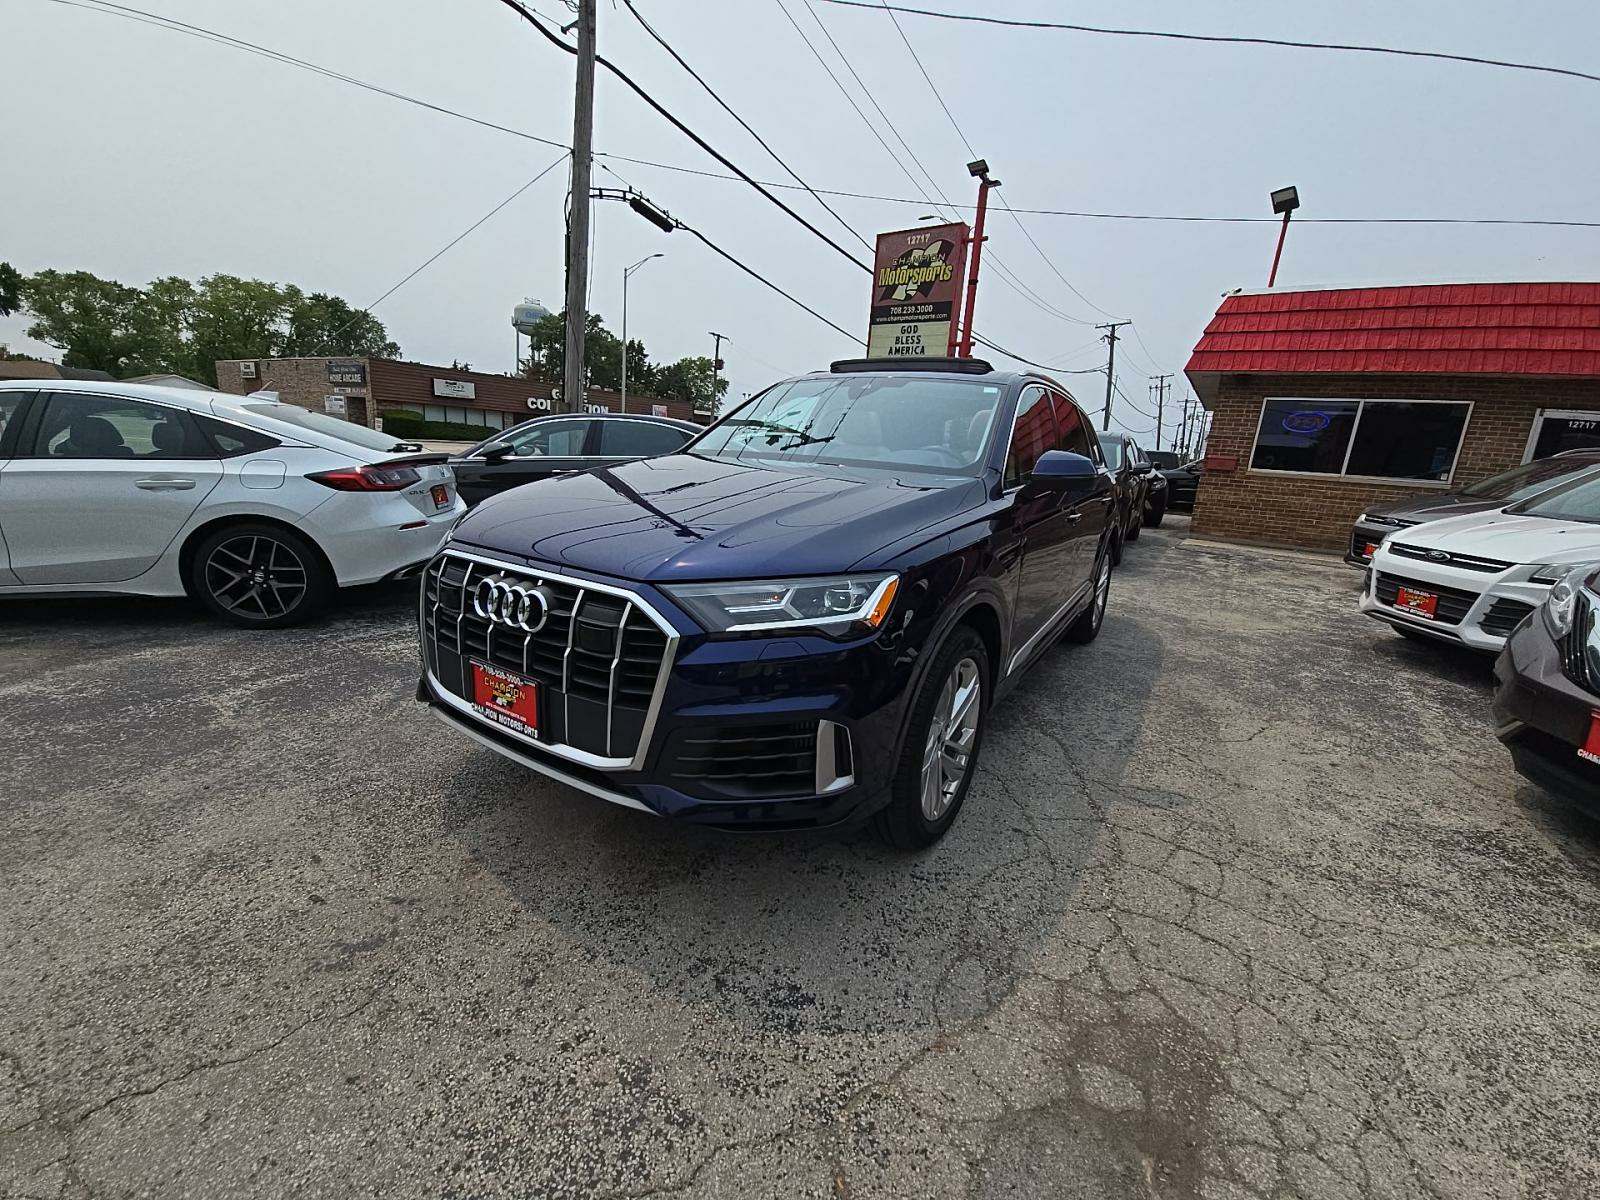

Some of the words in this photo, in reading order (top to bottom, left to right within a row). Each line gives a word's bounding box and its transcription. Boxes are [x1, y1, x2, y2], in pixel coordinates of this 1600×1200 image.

[907, 233, 931, 245] 12717
[879, 265, 953, 286] Motorsports
[890, 305, 933, 315] 708.239.3000
[900, 325, 919, 334] GOD
[895, 335, 921, 345] BLESS
[888, 346, 925, 356] AMERICA
[1568, 420, 1597, 429] 12717
[484, 677, 526, 700] CHAMPION
